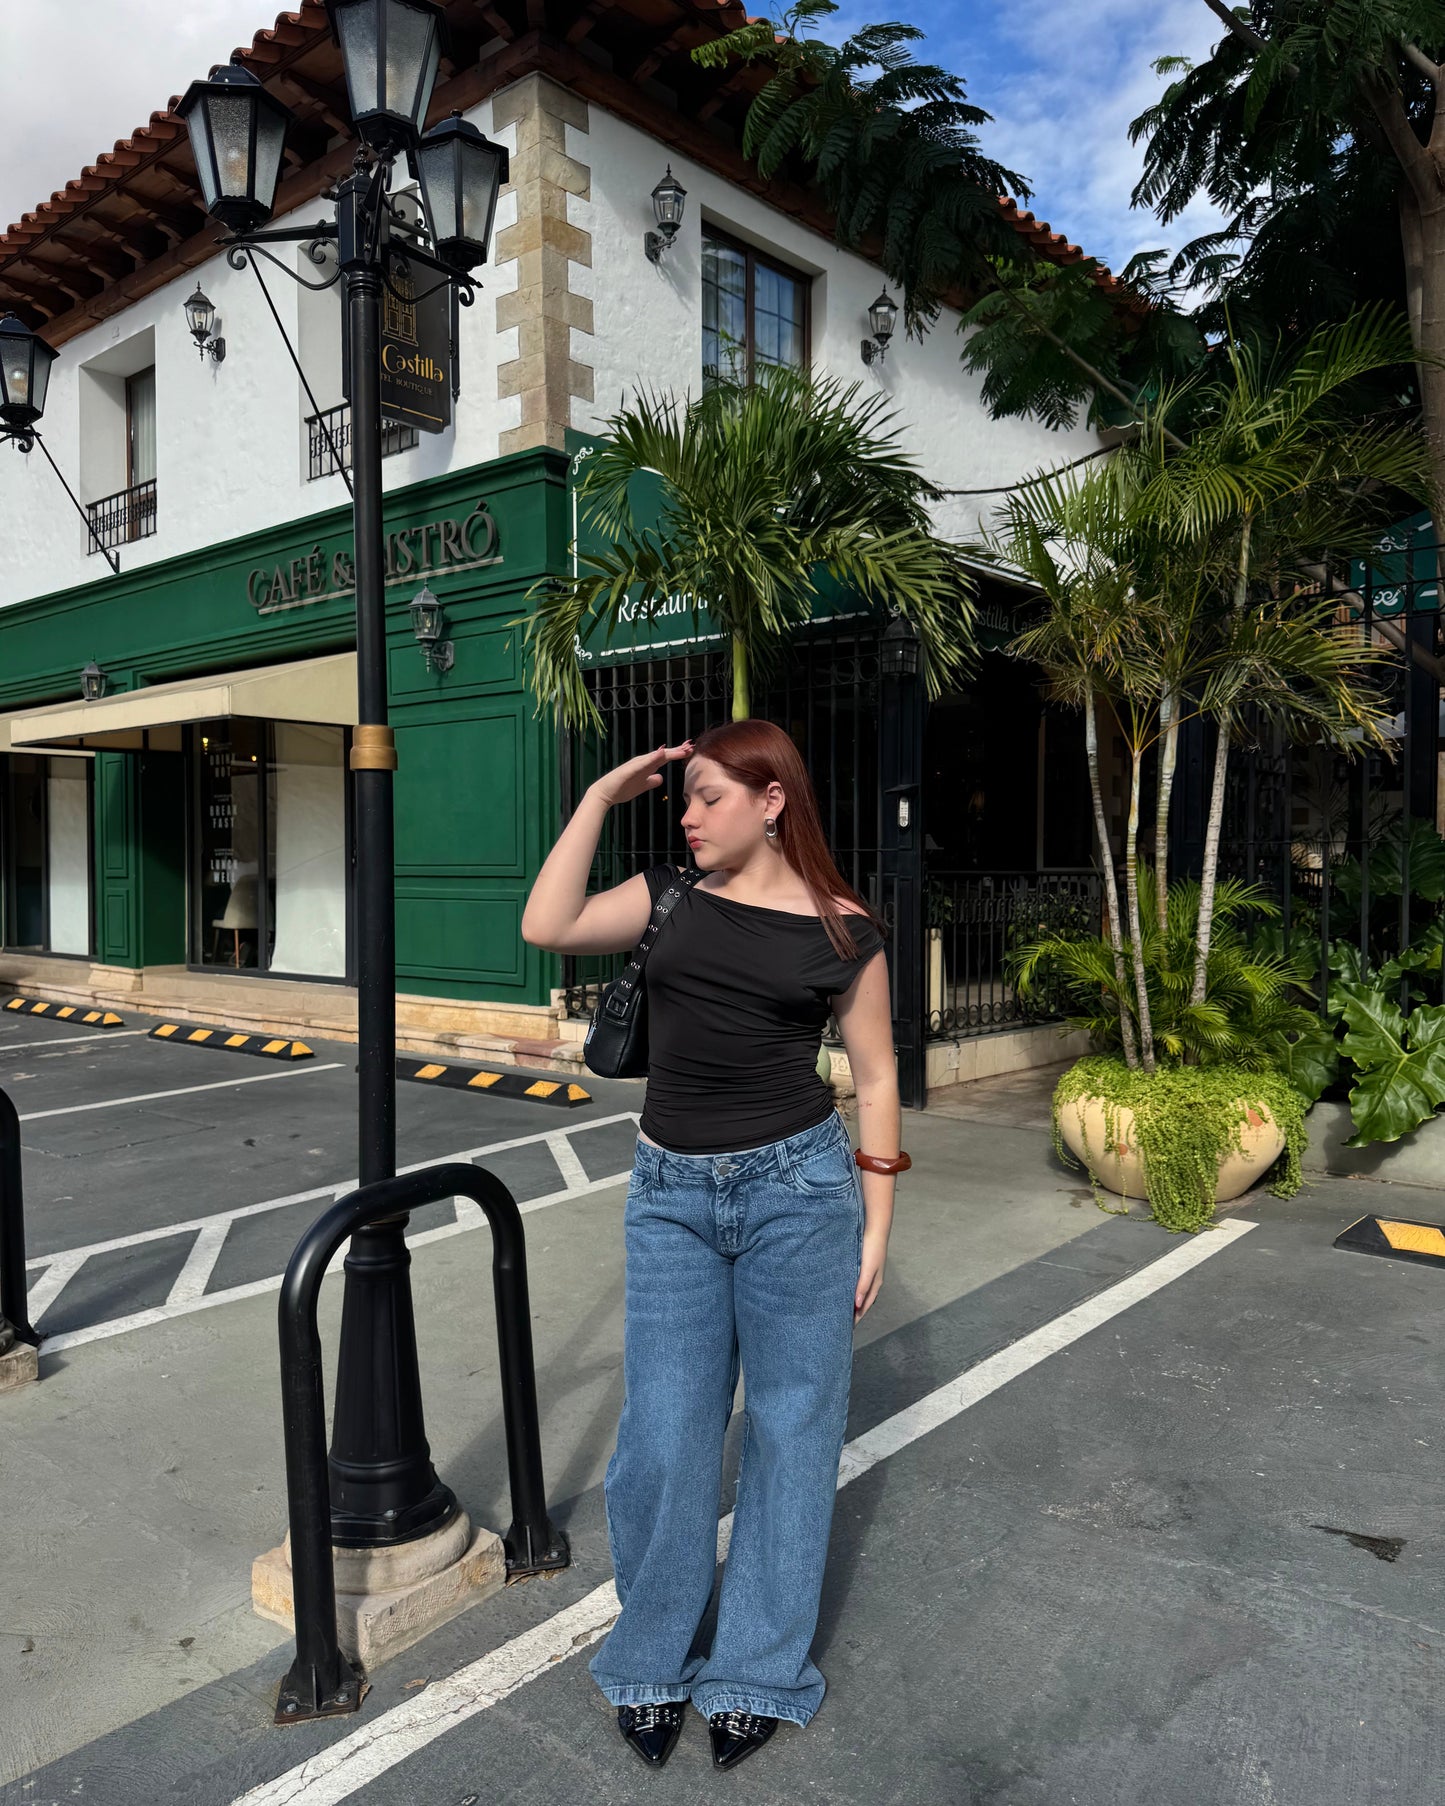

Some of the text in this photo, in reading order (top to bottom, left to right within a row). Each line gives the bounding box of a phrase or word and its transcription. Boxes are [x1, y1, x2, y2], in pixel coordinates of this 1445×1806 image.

[382, 344, 444, 383] Castilla
[396, 377, 433, 395] BOUTIQUE
[247, 500, 499, 608] CAFÉ & ISTRÓ
[209, 804, 238, 817] BREAK
[212, 817, 235, 829] FAST
[213, 871, 236, 883] WELL
